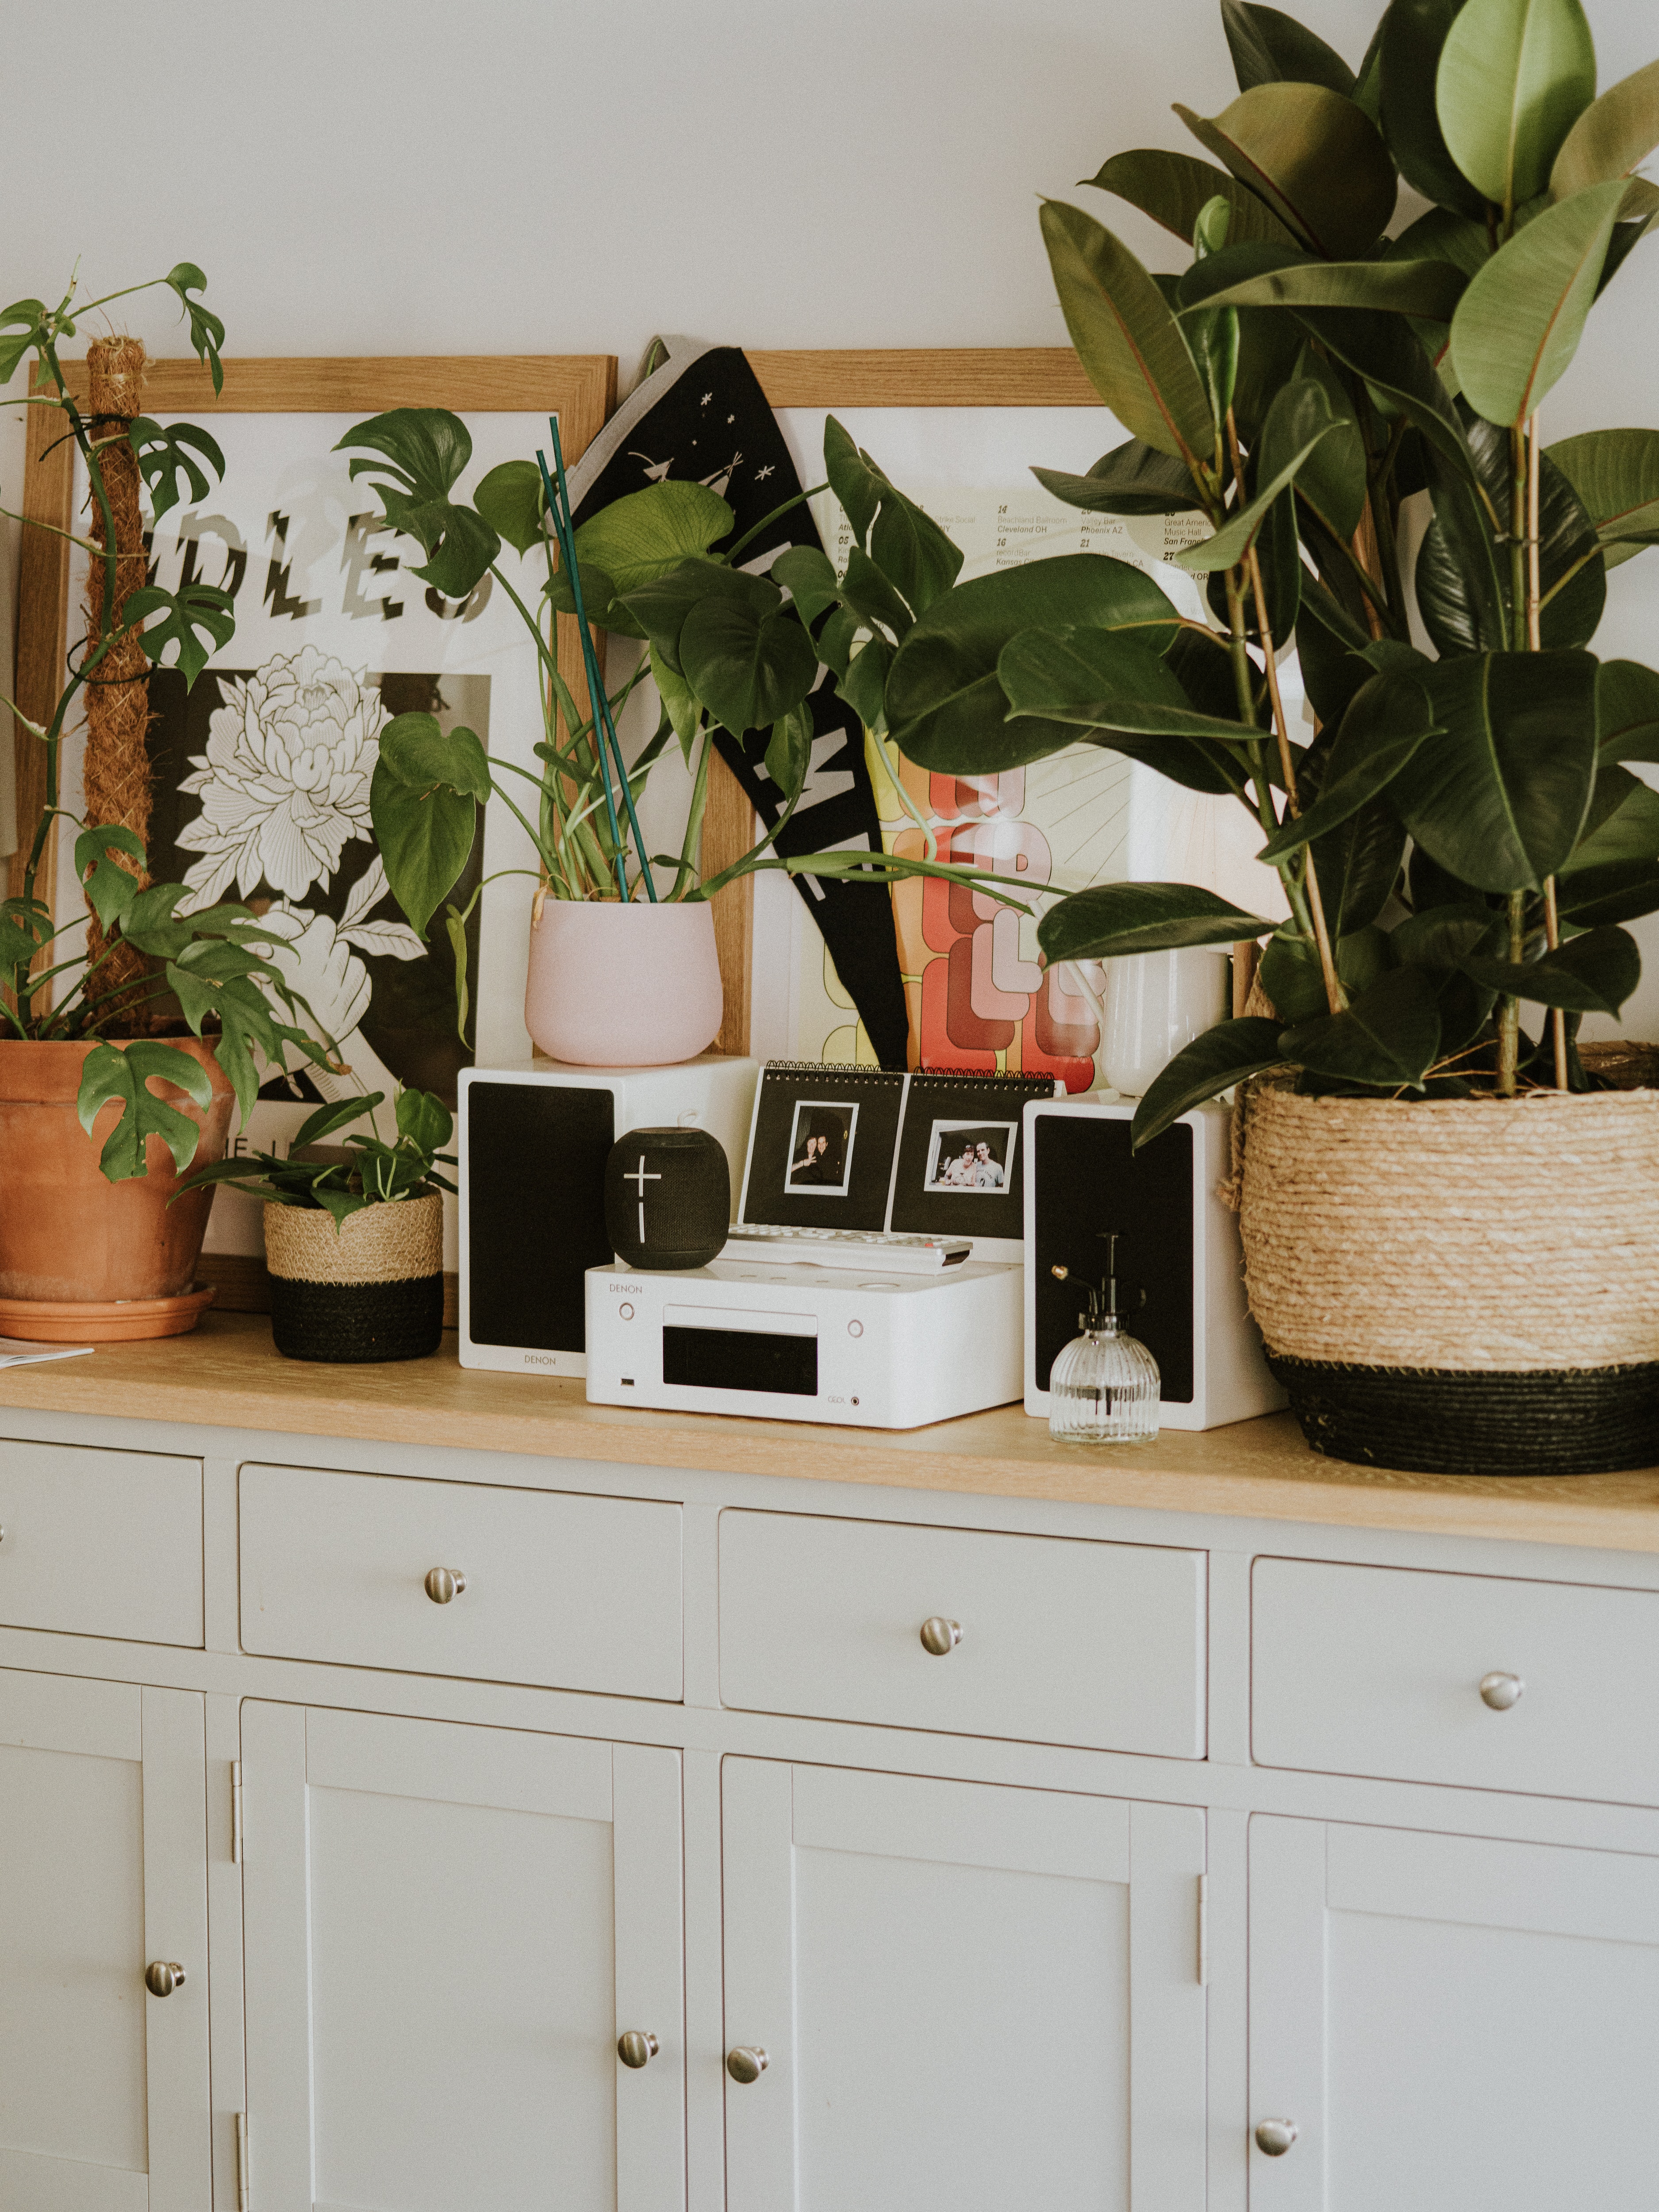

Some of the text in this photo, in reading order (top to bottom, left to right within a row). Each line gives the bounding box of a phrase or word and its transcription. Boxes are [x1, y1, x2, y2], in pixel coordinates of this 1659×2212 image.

[998, 505, 1007, 514] 14
[838, 536, 849, 545] 05
[1080, 539, 1090, 547] 21
[1163, 552, 1175, 561] 27
[610, 1284, 642, 1294] DENON
[525, 1355, 556, 1365] DENON
